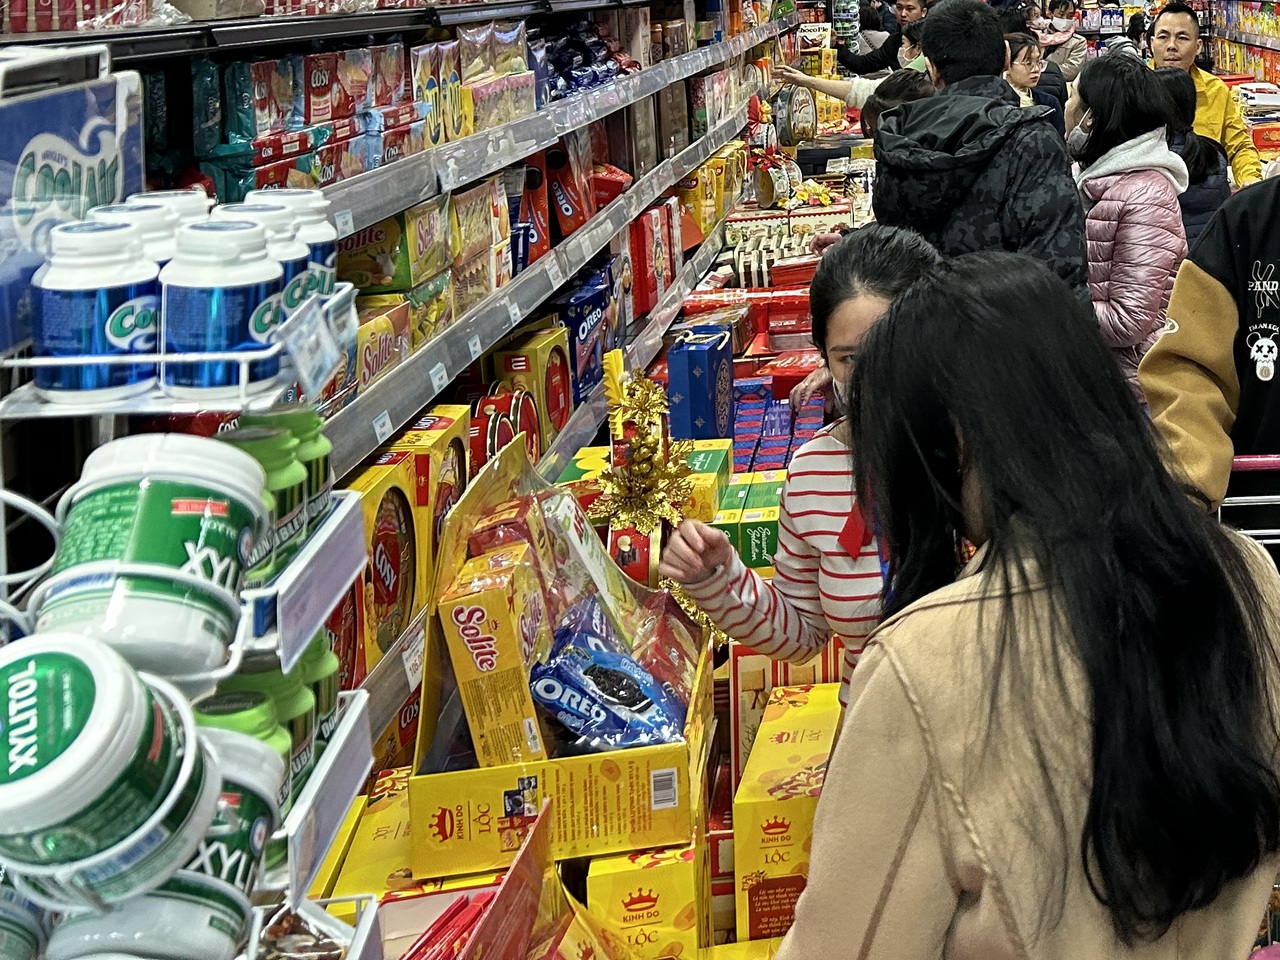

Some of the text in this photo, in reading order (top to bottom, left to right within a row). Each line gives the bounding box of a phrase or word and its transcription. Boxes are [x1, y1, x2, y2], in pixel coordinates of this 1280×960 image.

[310, 69, 330, 88] COSY
[579, 308, 602, 342] OREO
[361, 331, 394, 386] Solite
[374, 541, 397, 593] COSY
[452, 605, 500, 672] Solite
[400, 699, 420, 730] COS
[534, 676, 608, 723] OREO
[8, 659, 38, 776] XYLITOL
[472, 802, 492, 835] LỘC
[764, 851, 790, 866] LỘC
[622, 912, 645, 923] KINH
